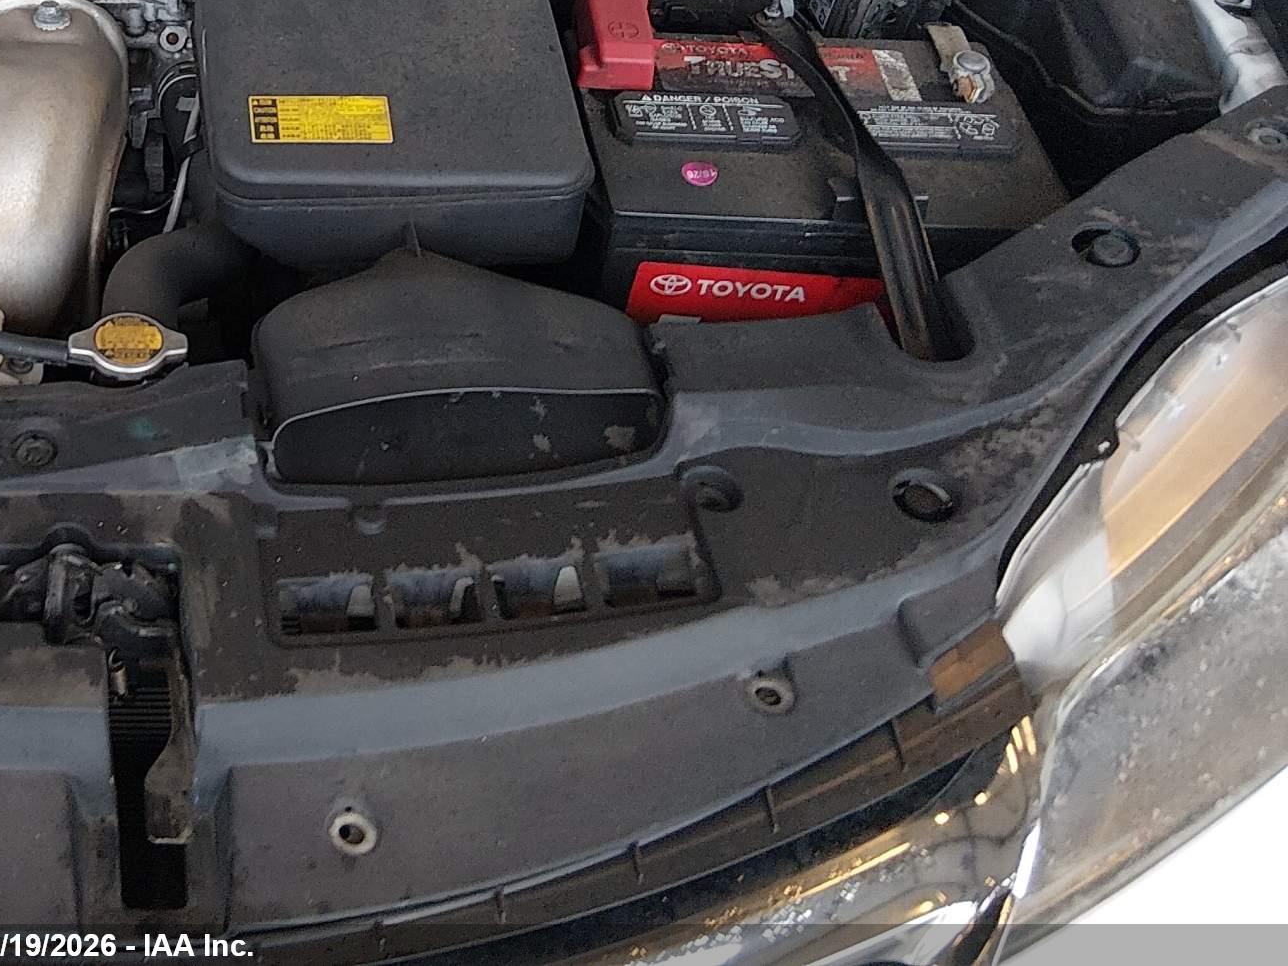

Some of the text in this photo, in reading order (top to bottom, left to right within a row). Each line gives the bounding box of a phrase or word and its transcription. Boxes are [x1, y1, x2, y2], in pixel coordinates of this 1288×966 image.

[686, 44, 748, 57] TOYOTA
[652, 94, 702, 103] DANGER
[713, 96, 759, 105] POISON
[697, 279, 806, 303] TOYOTA
